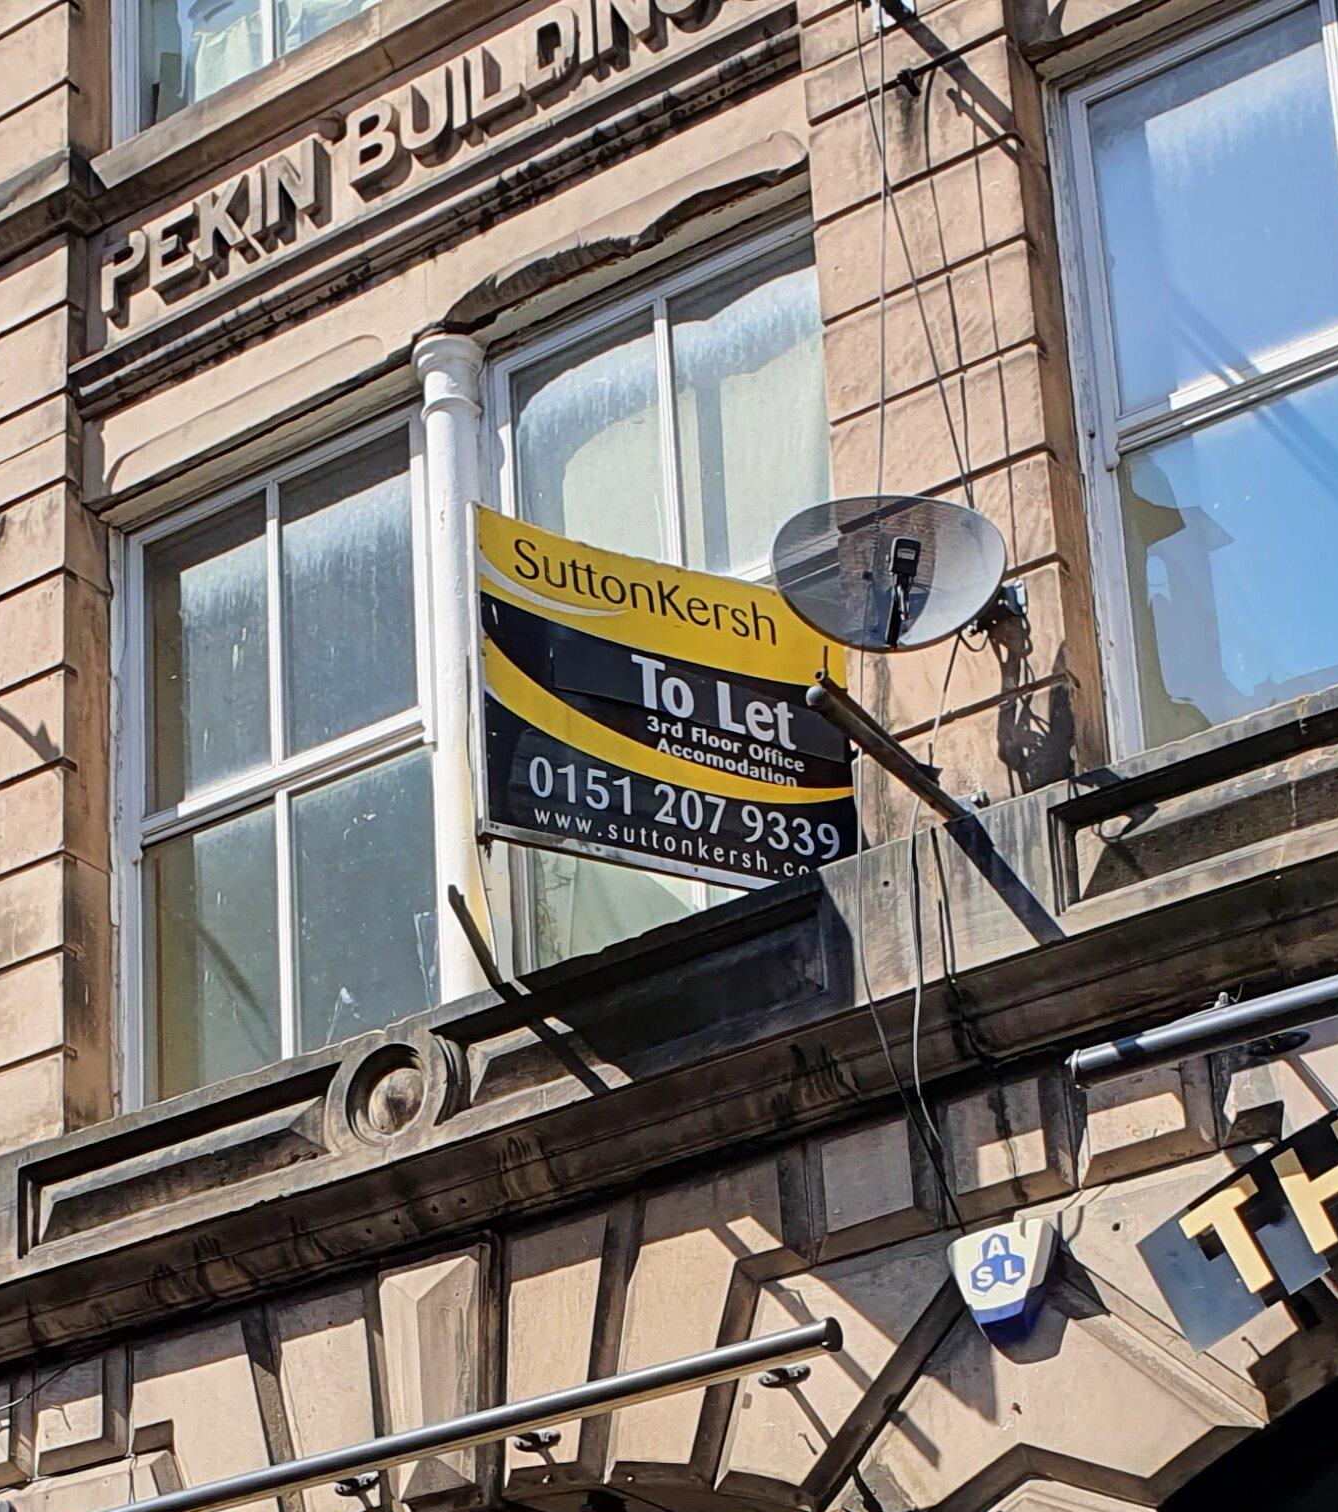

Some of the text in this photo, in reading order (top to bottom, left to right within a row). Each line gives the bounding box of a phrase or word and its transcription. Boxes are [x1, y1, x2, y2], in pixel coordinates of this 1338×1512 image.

[100, 0, 718, 318] PEKIN BUILDIN
[513, 538, 777, 646] SuttonKersh
[630, 654, 797, 751] To Let
[646, 715, 806, 773] 3rd Floor Office
[529, 756, 840, 860] 0151 207 9339
[657, 739, 798, 788] Accomodation
